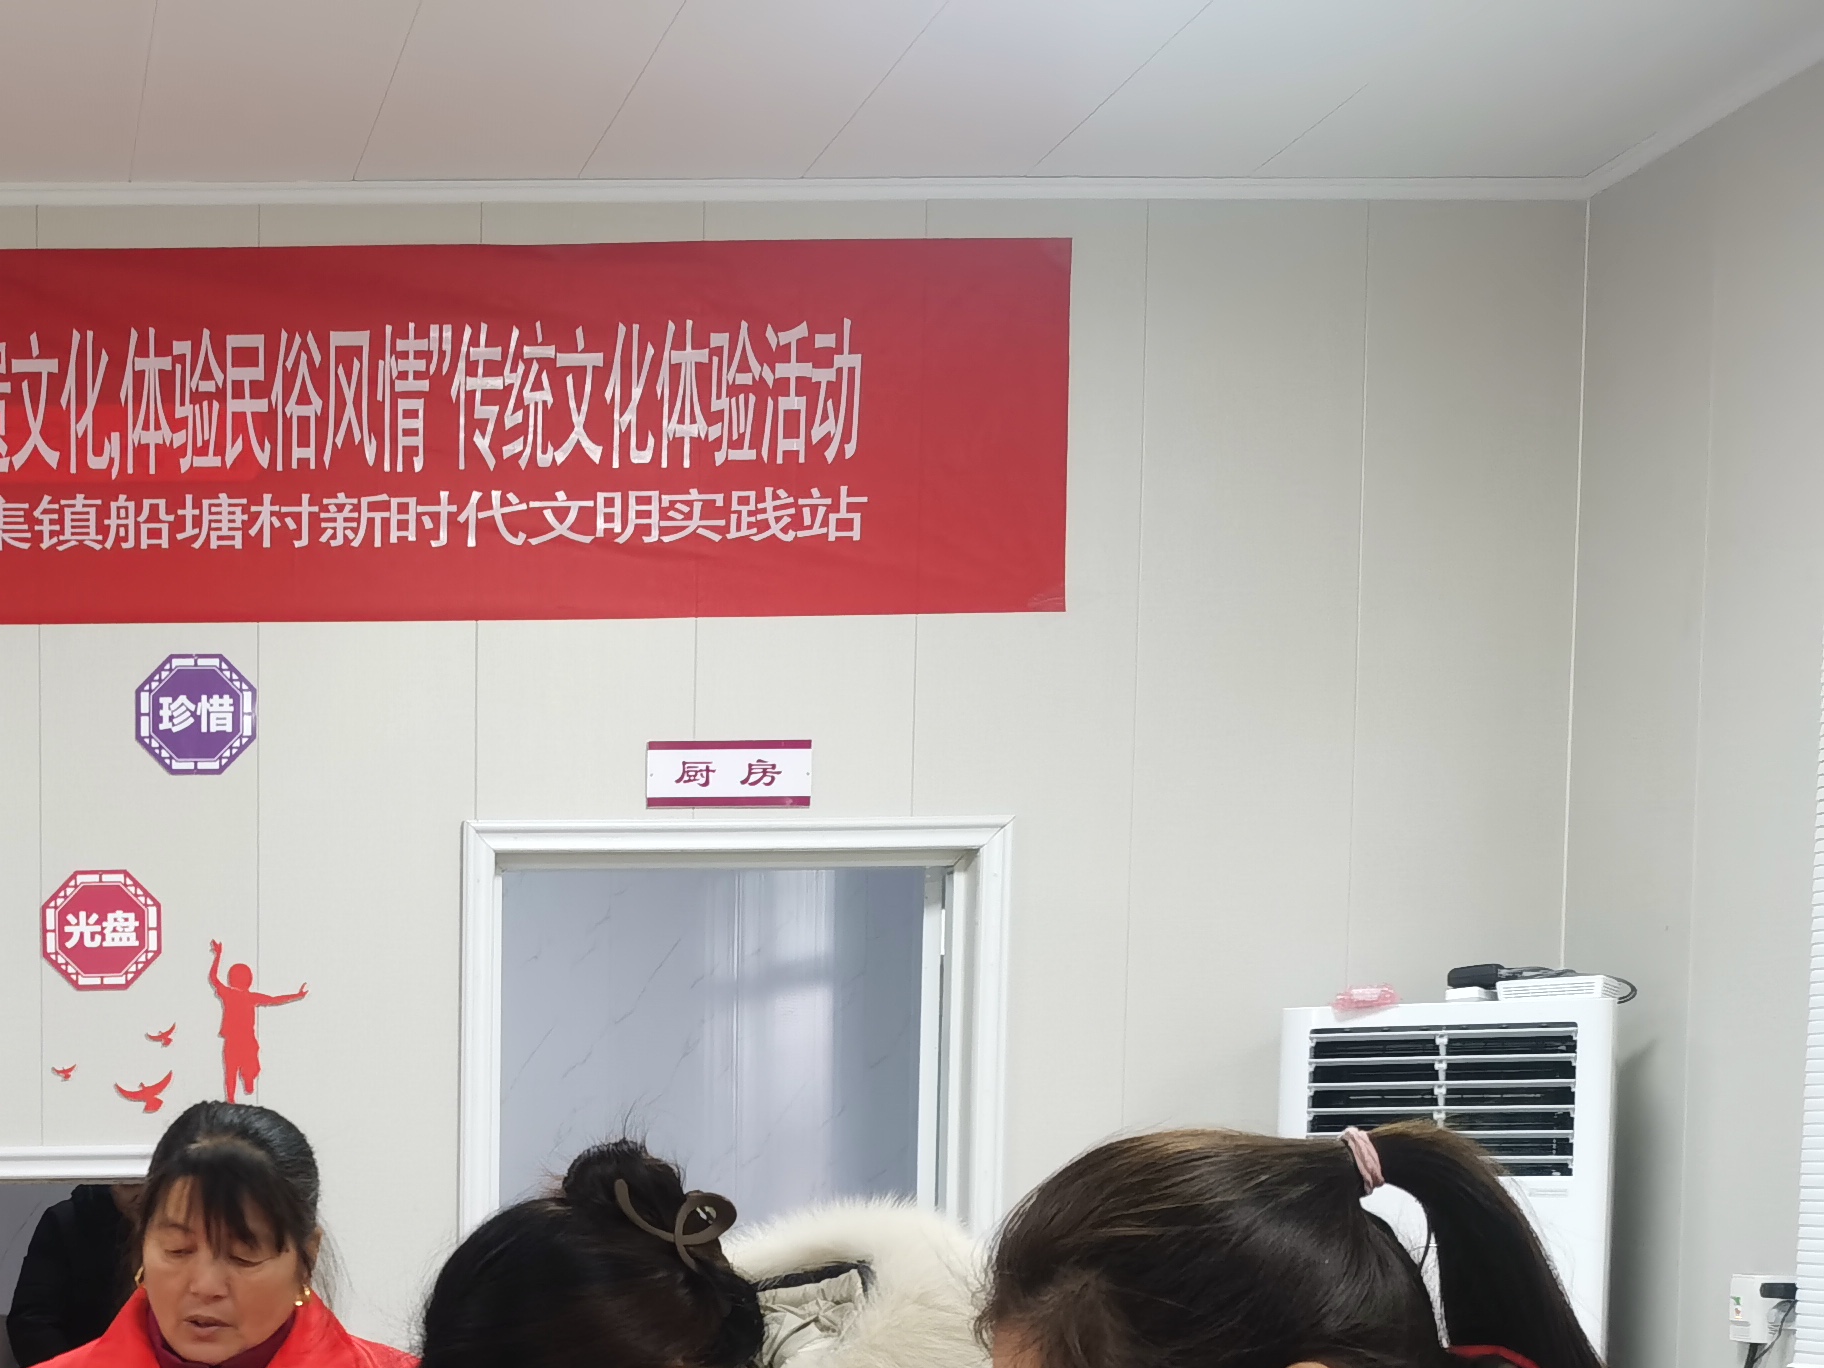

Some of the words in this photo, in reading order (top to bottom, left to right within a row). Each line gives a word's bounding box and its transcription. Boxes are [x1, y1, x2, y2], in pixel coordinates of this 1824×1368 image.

[159, 695, 235, 734] 珍惜
[674, 759, 783, 788] 厨房
[64, 910, 141, 949] 光盘
